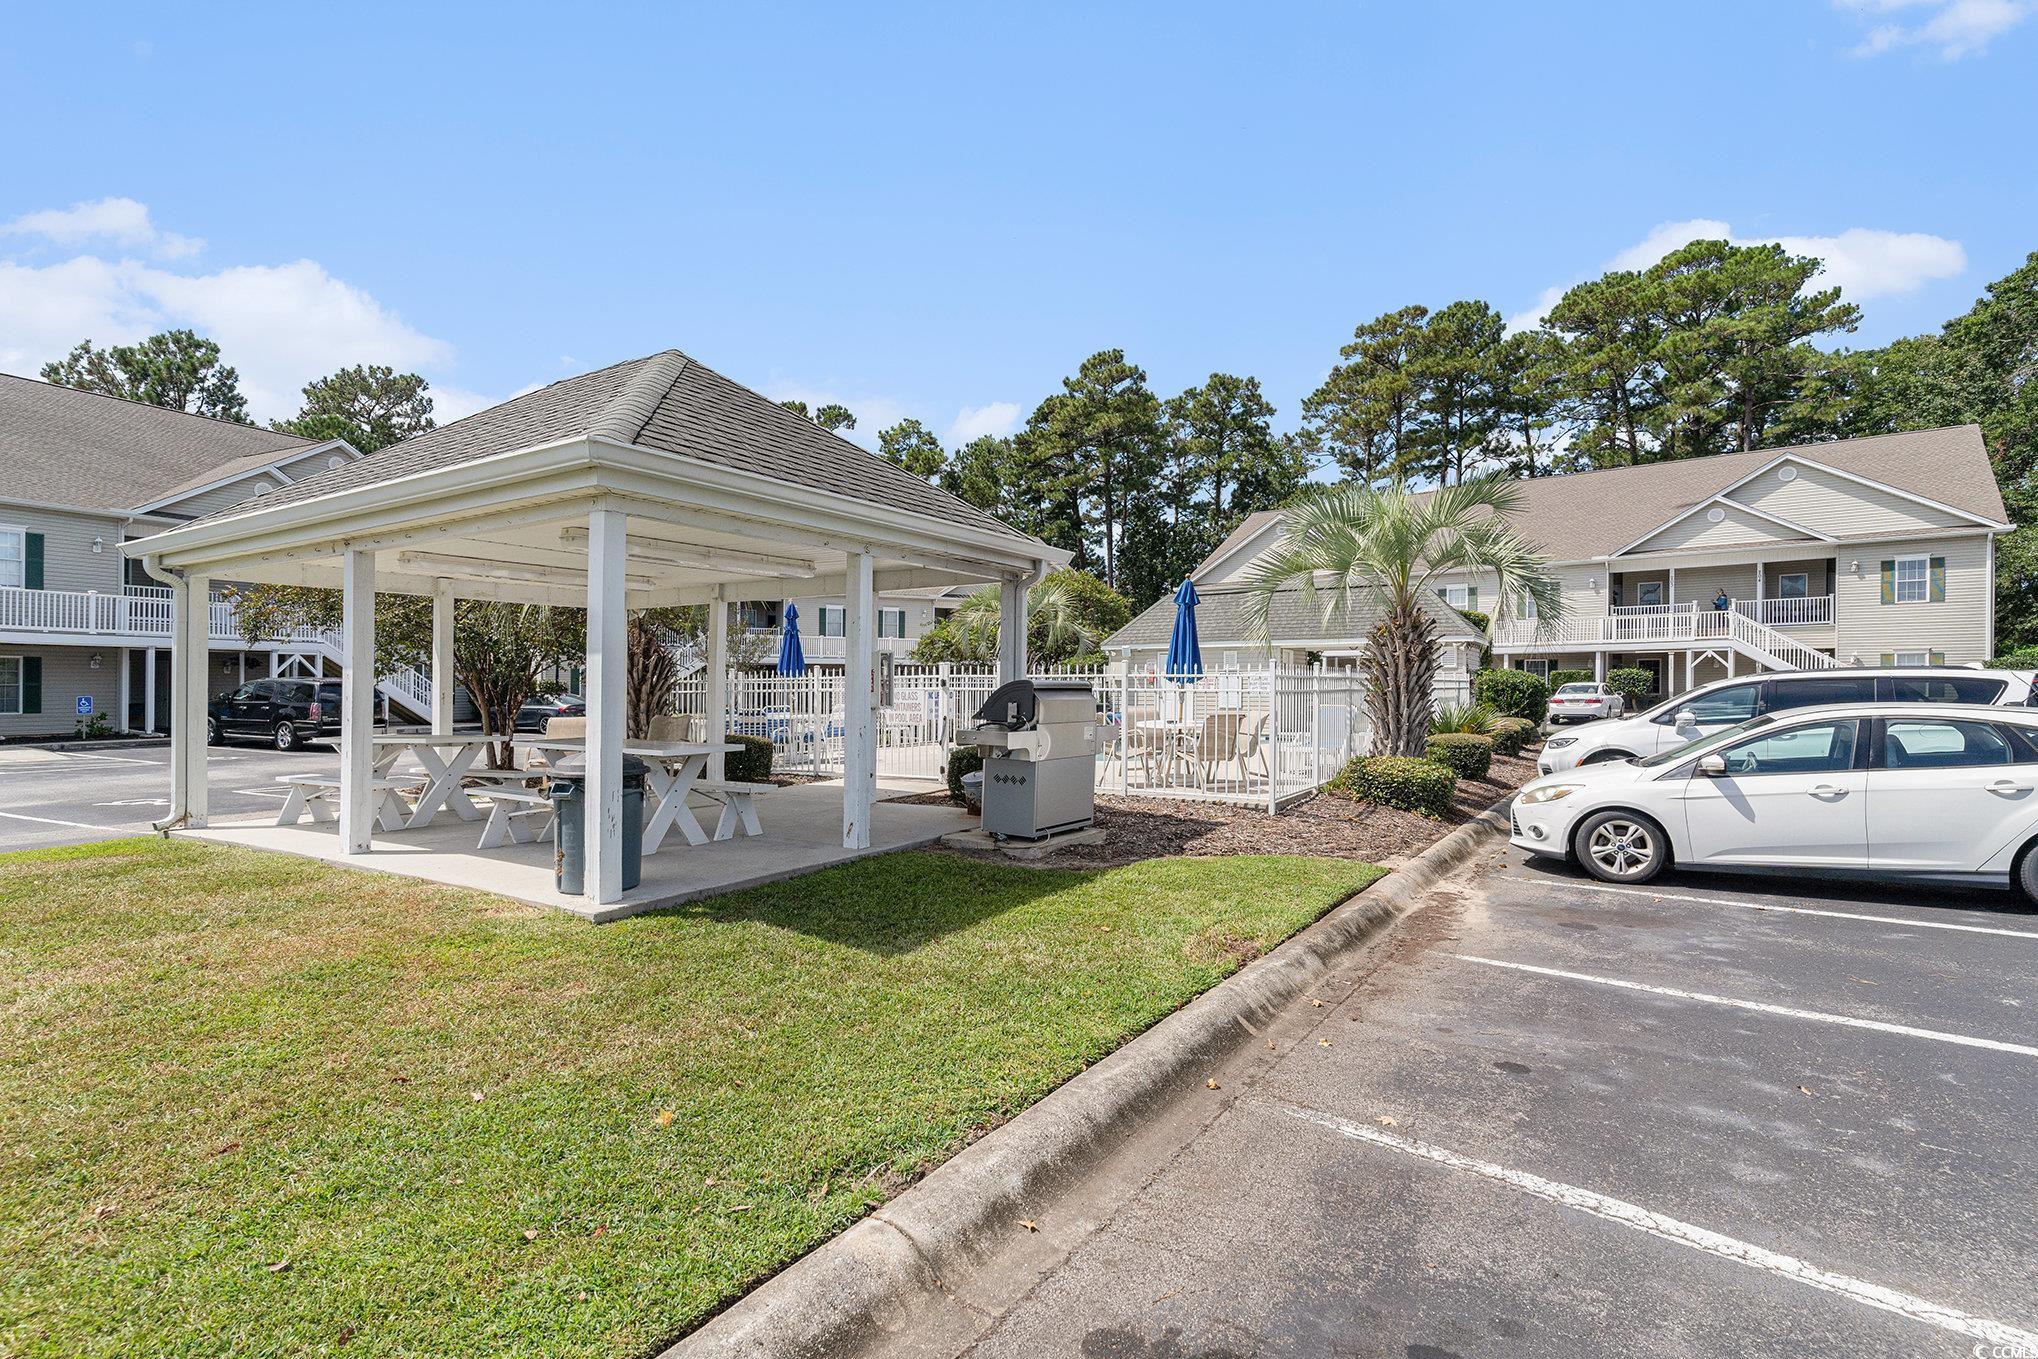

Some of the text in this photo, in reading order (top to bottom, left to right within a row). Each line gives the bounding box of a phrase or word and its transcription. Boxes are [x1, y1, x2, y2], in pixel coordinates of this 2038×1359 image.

[901, 691, 918, 701] GLASS
[895, 713, 909, 722] POOL
[909, 713, 923, 723] AREA
